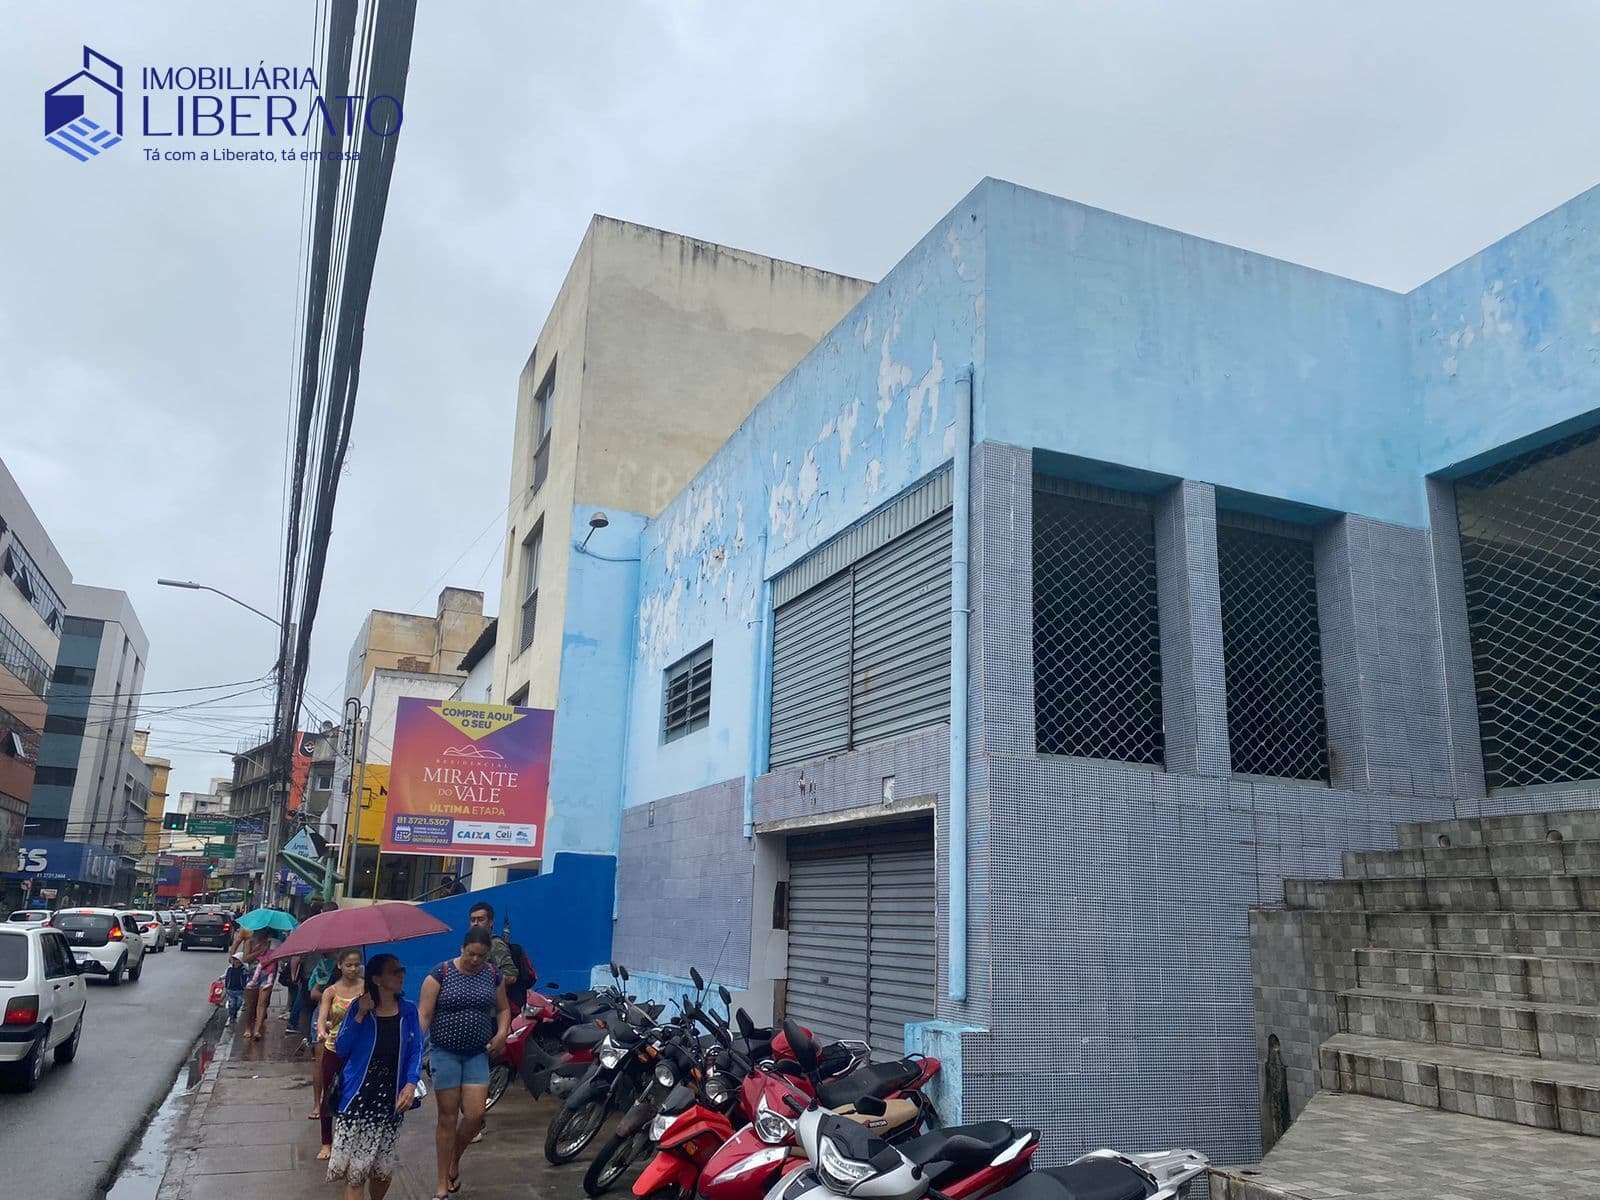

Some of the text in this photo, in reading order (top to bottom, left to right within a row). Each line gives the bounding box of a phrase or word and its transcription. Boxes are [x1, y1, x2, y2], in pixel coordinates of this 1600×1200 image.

[442, 708, 513, 722] COMPRE AQUI
[461, 719, 492, 729] O SEU
[423, 767, 519, 788] MIRANTE
[438, 785, 501, 803] DO VALE
[430, 801, 506, 816] ÚLTIMA ETAPA
[456, 831, 491, 840] CAIXA
